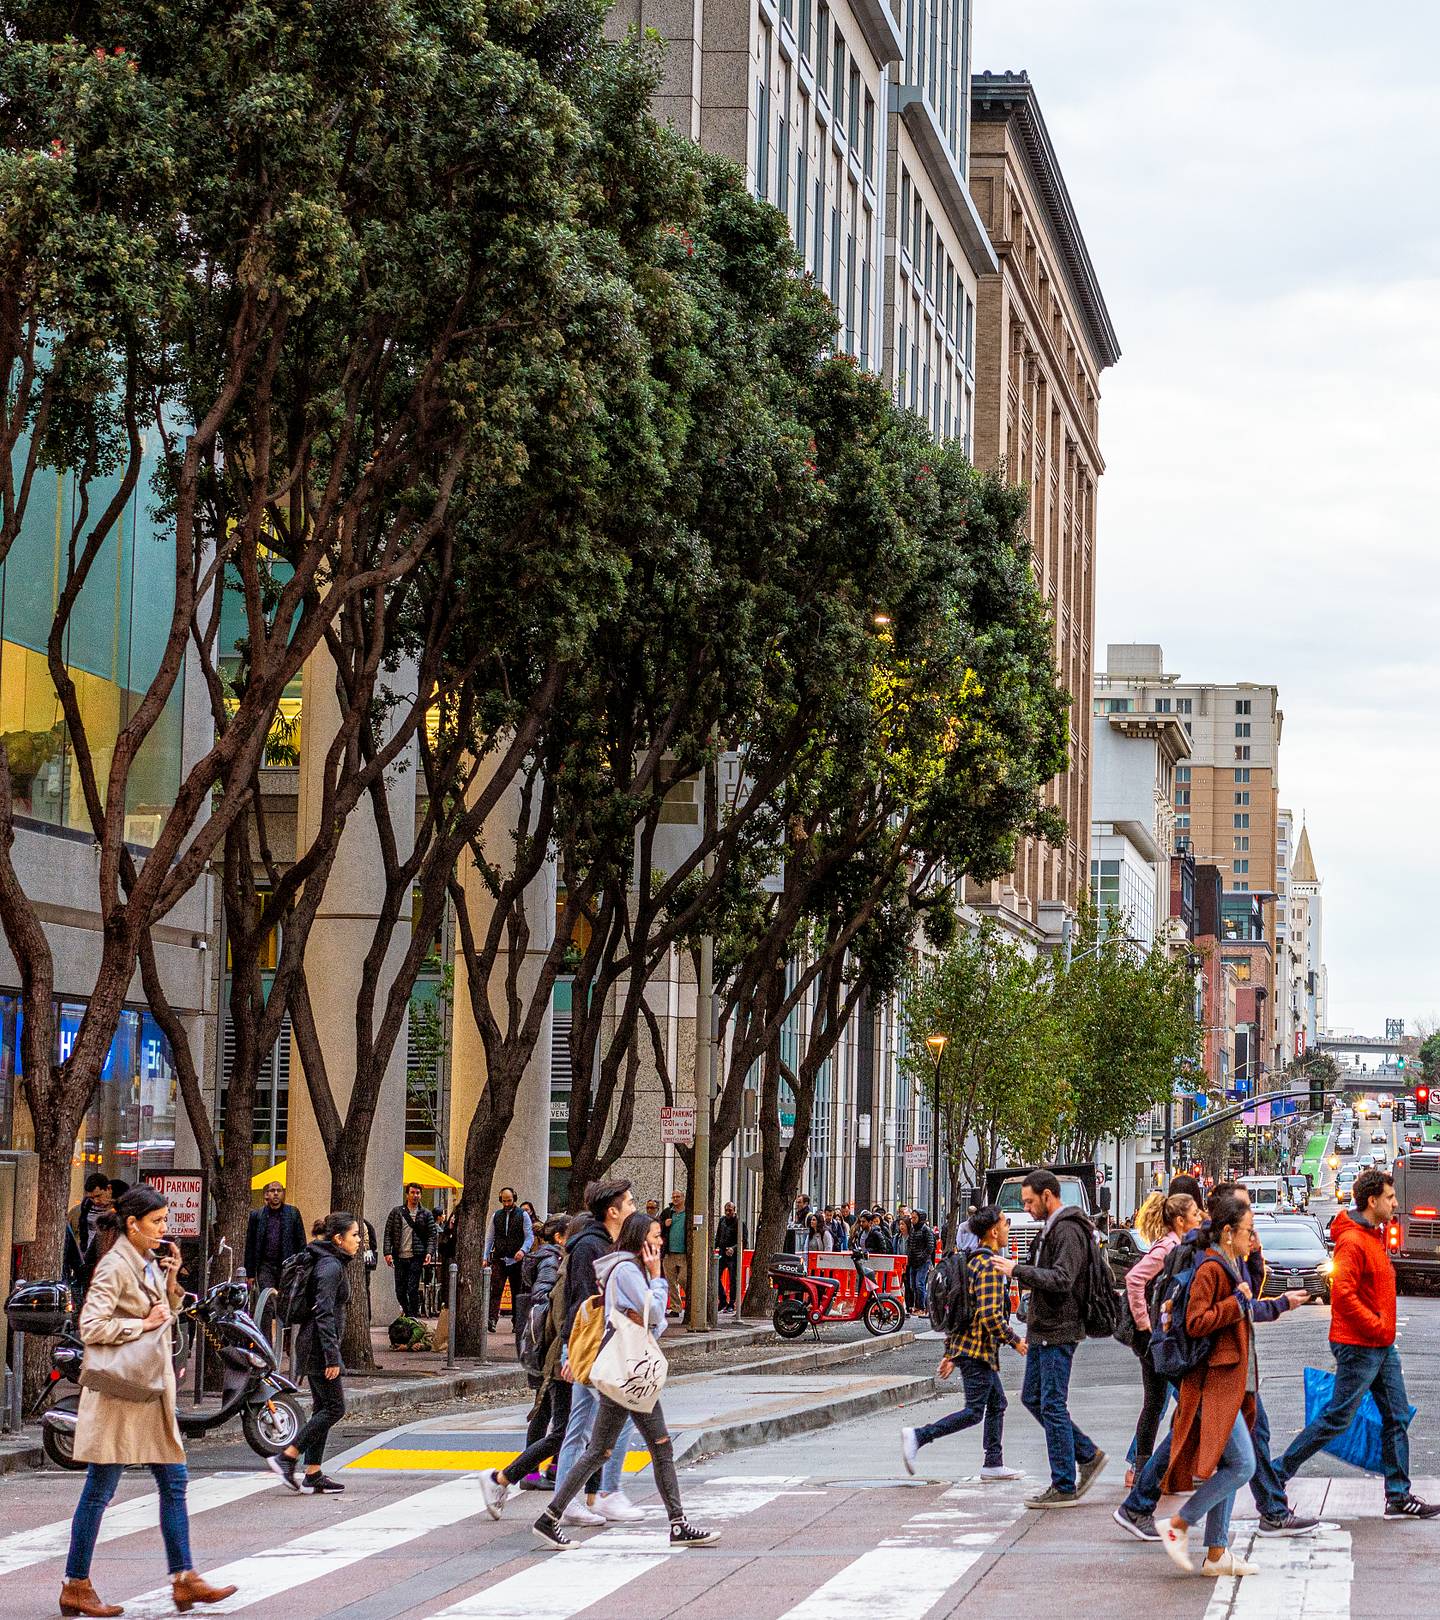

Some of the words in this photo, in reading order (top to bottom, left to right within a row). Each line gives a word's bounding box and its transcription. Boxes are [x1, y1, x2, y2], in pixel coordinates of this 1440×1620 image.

[166, 1181, 201, 1193] PARKING
[174, 1213, 196, 1223] THURS
[778, 1264, 799, 1273] scoot
